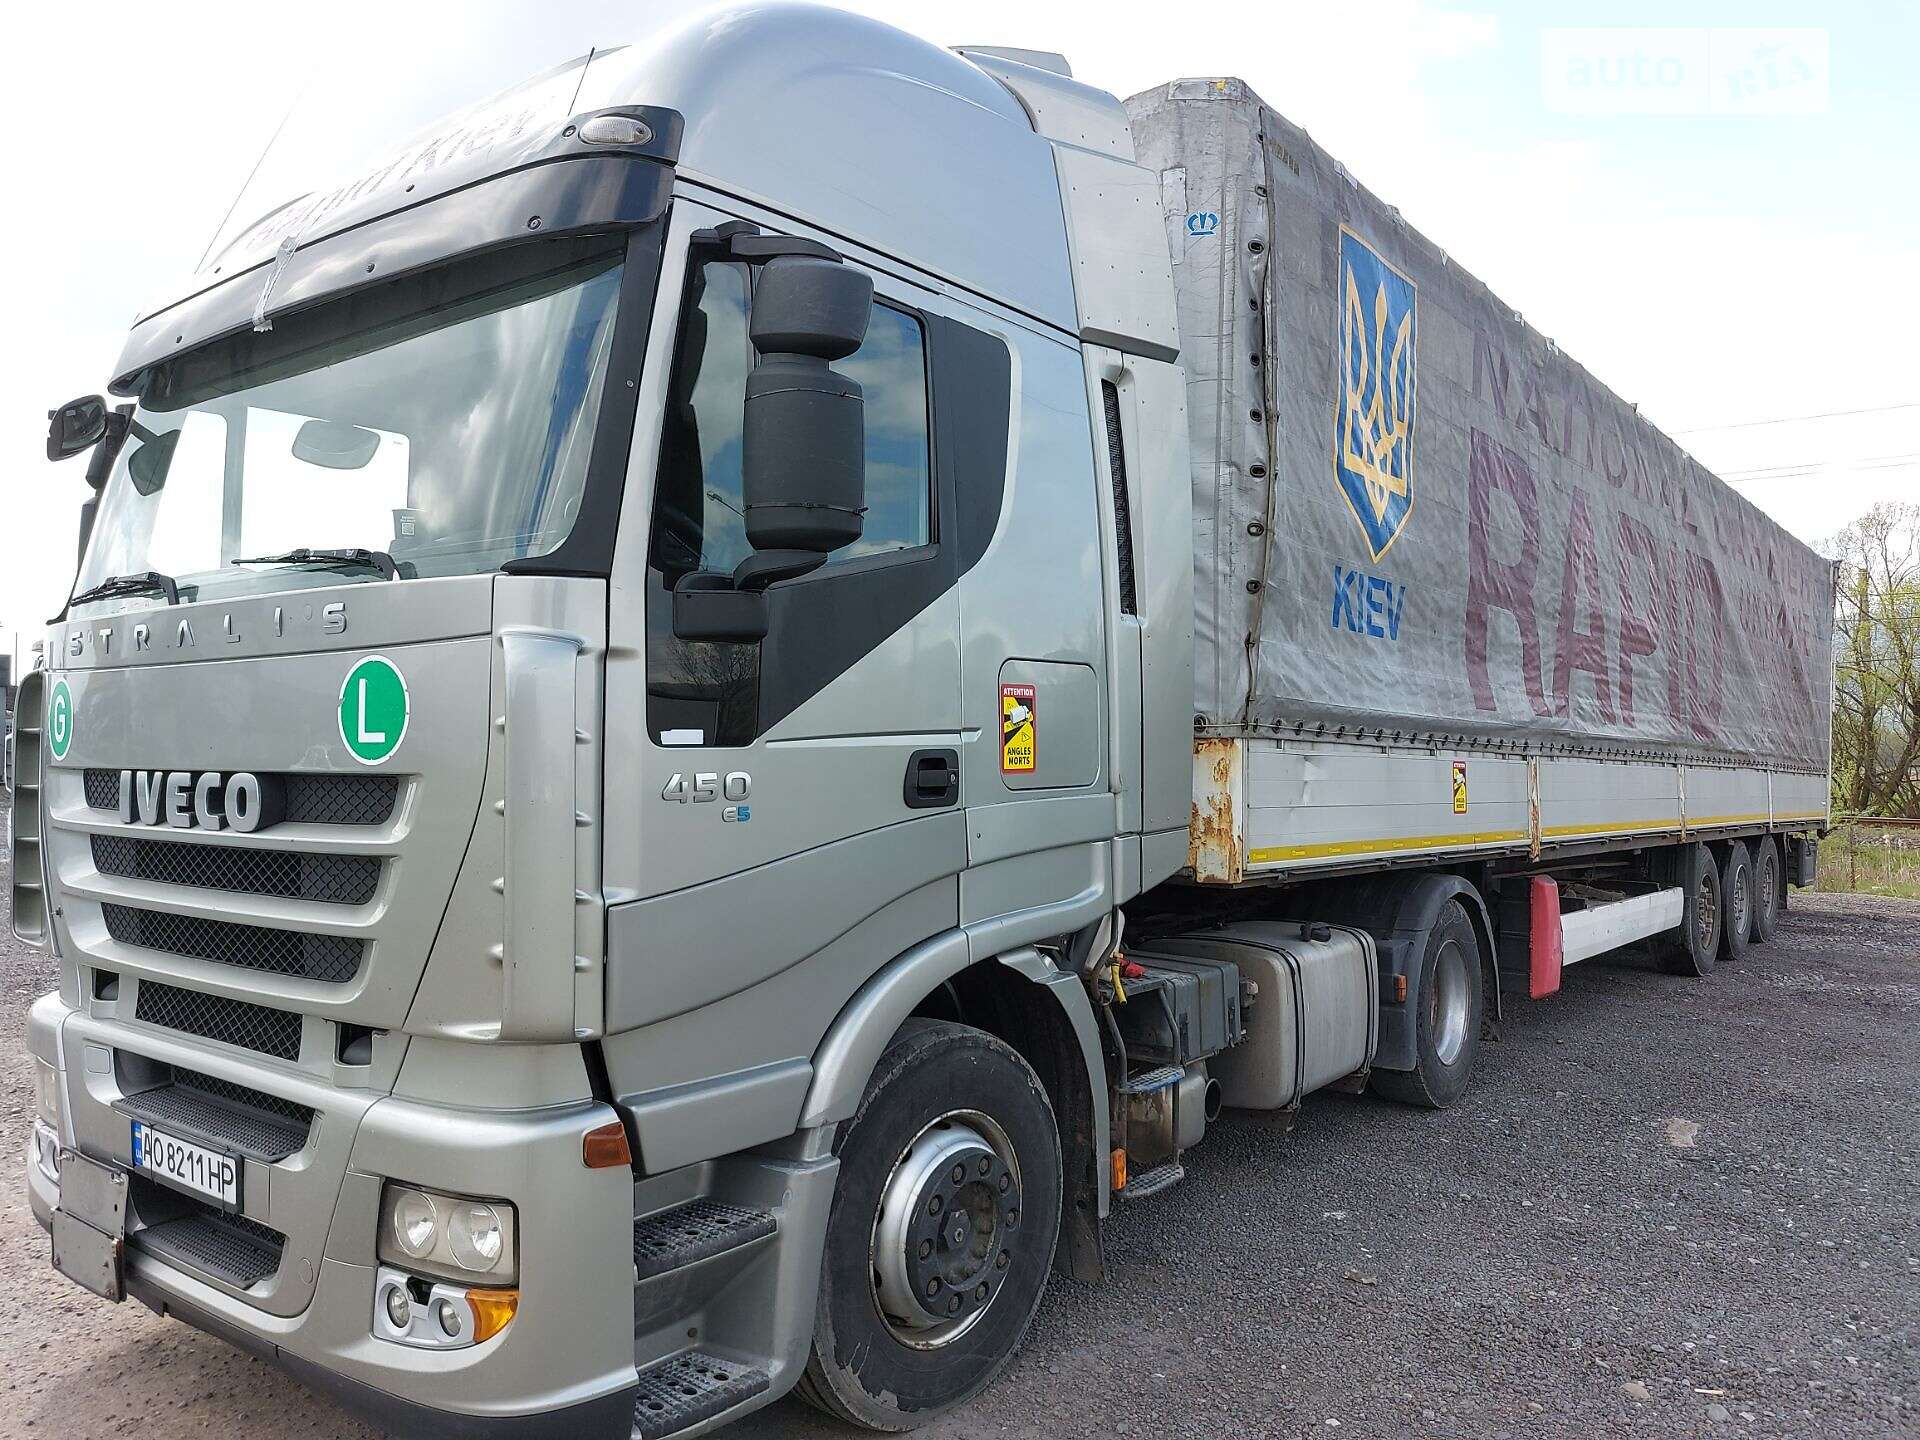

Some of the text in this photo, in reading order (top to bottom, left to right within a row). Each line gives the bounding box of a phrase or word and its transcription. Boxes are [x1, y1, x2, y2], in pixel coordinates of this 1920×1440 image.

[1332, 565, 1406, 640] KIEV
[1465, 426, 1725, 741] RAPID
[69, 602, 347, 657] STRALIS
[357, 678, 386, 743] L
[1003, 687, 1033, 696] ATTENTION
[54, 694, 66, 743] G
[1007, 746, 1031, 755] ANGLES
[1008, 756, 1030, 765] MORTS
[118, 769, 263, 833] IVECO
[661, 771, 752, 804] 450
